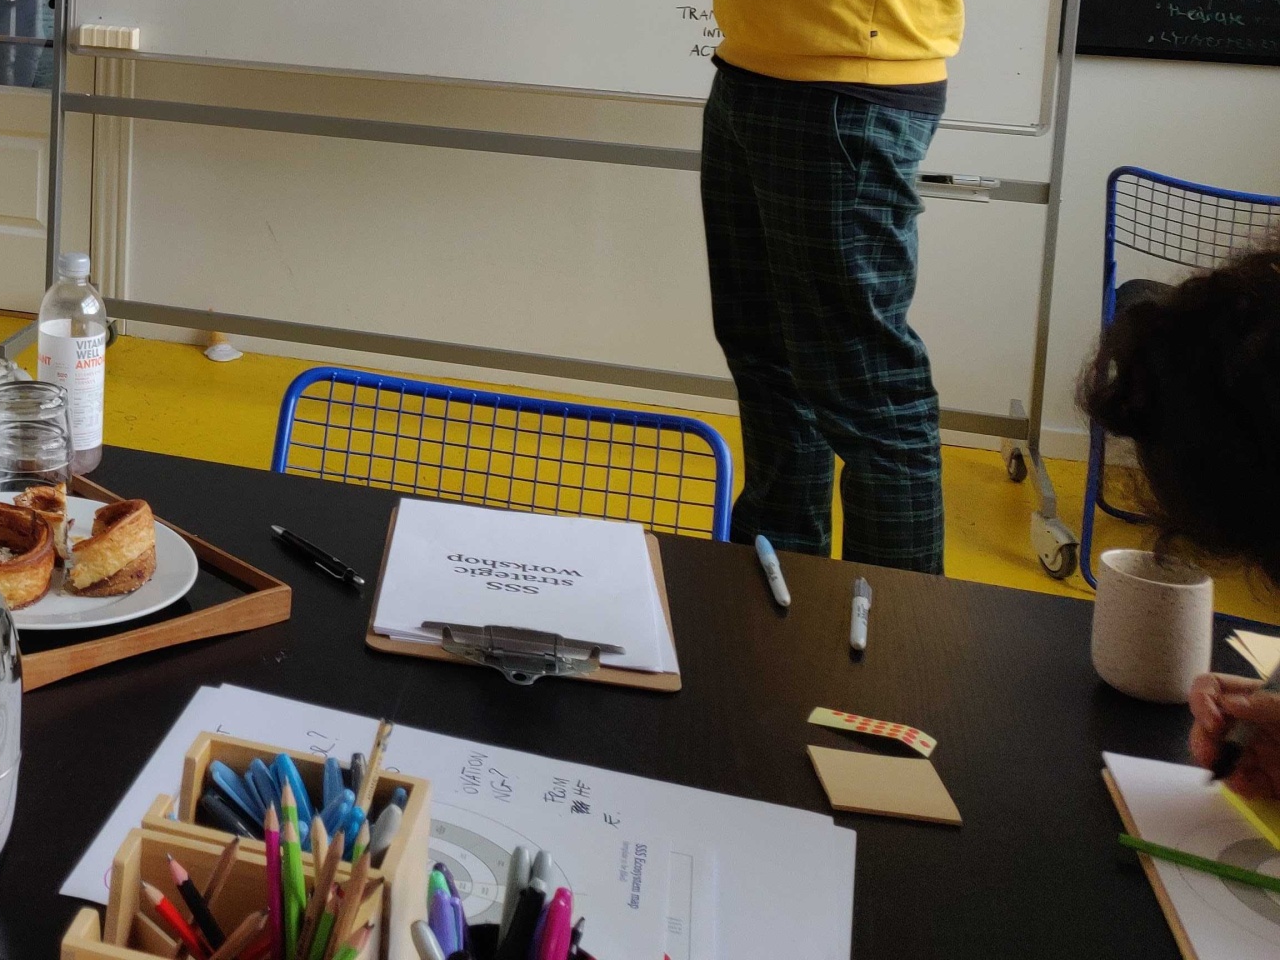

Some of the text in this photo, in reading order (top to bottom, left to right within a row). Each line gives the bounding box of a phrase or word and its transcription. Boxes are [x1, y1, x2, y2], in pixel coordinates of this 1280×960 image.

[76, 348, 99, 359] WELL
[447, 553, 583, 578] workshop
[454, 566, 574, 587] strategic
[486, 581, 540, 595] SSS
[627, 843, 648, 909] SSS Ecosystem map
